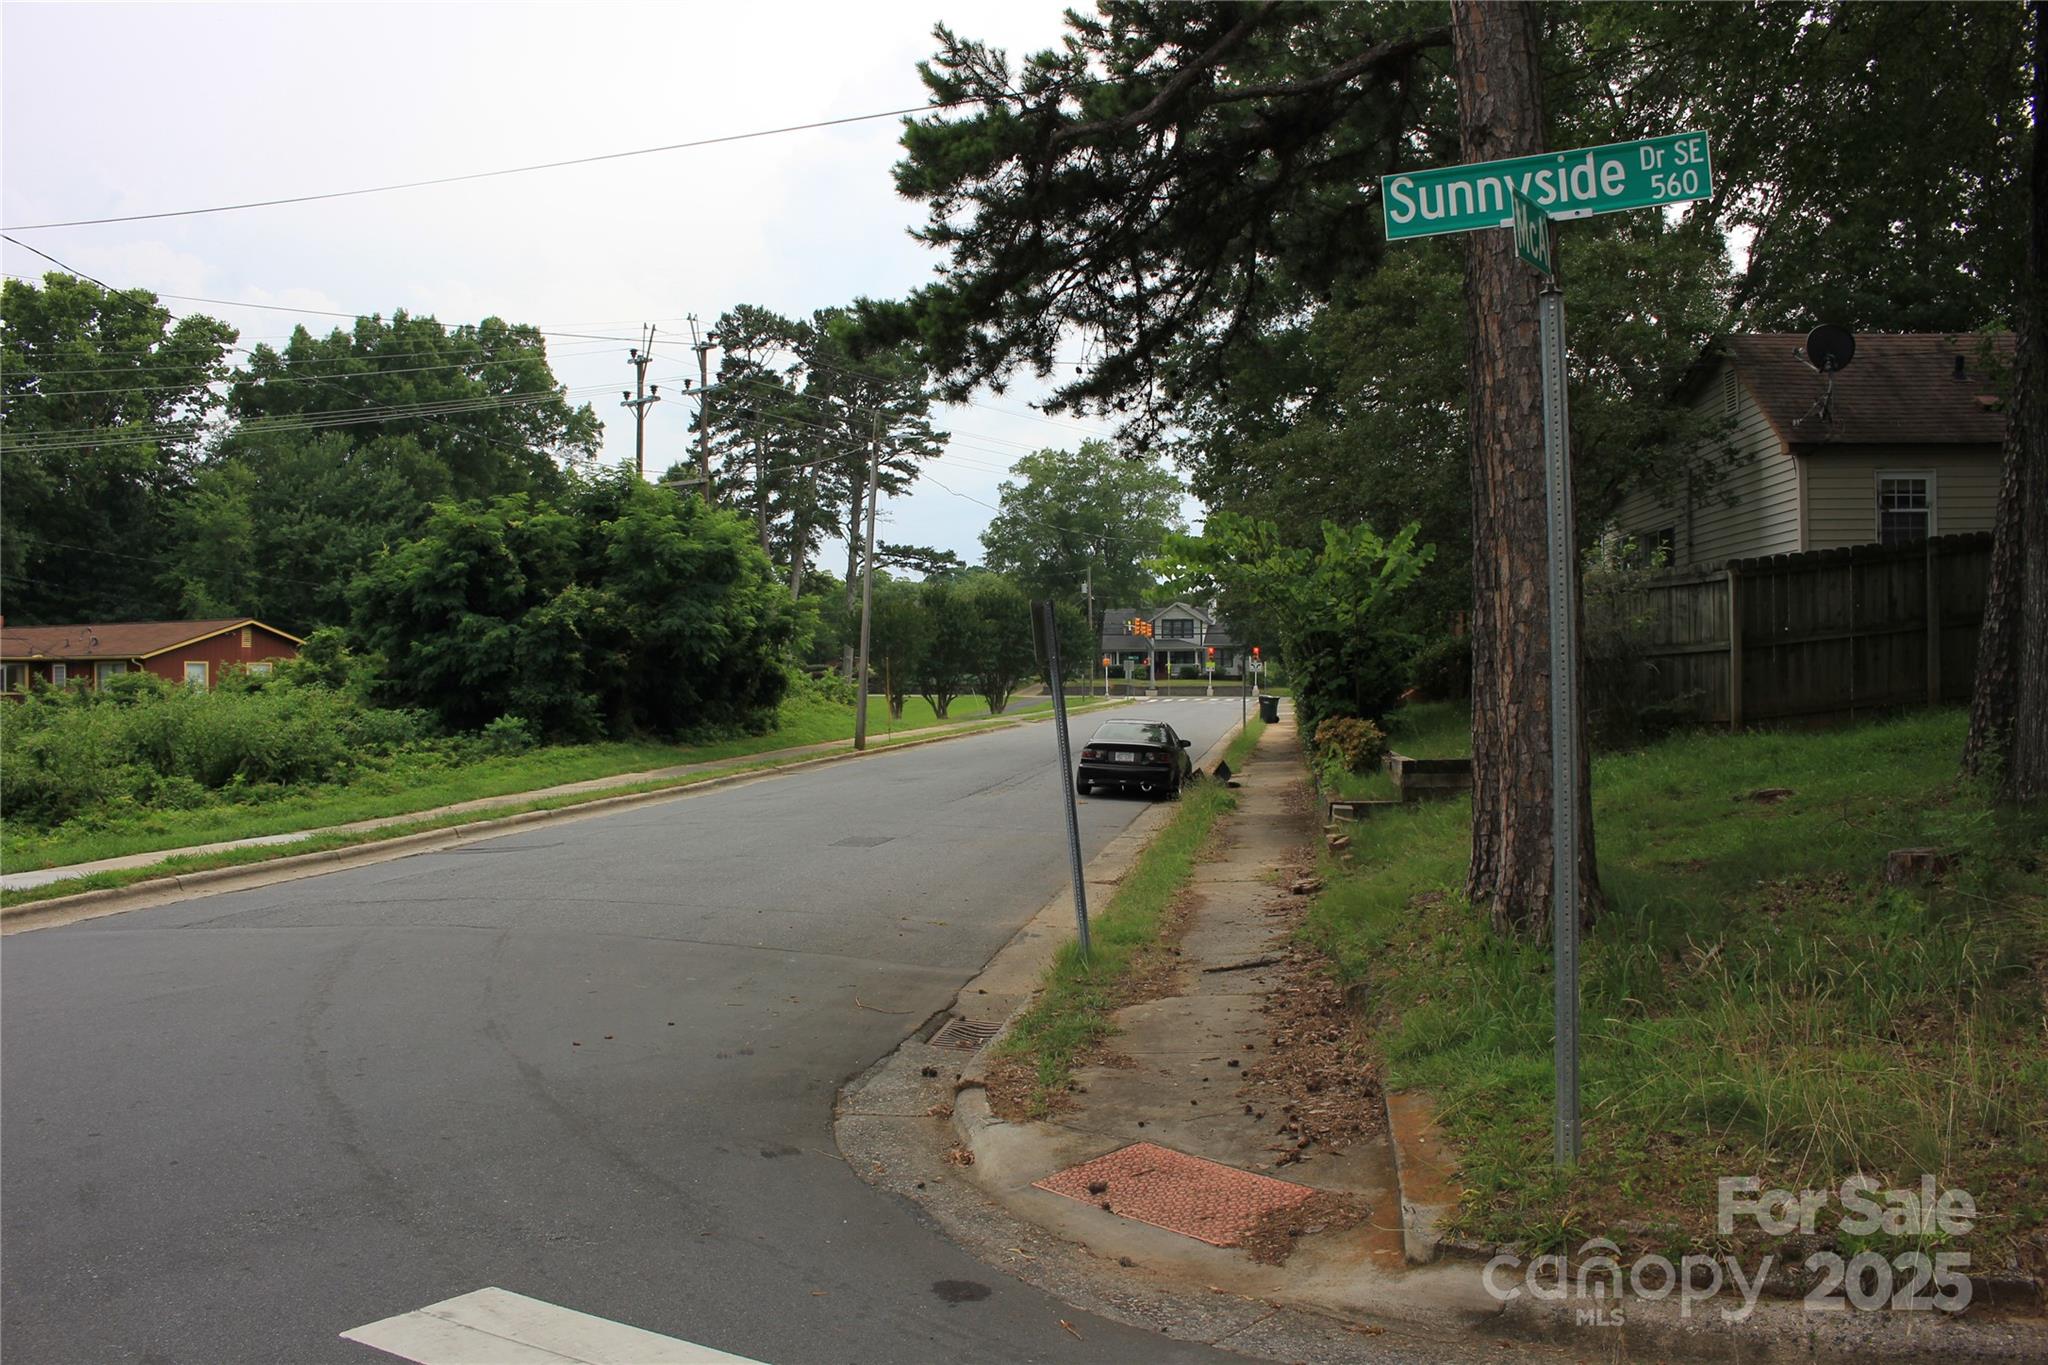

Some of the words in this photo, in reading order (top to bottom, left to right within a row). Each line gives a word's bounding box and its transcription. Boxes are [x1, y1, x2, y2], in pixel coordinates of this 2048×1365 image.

[1640, 145, 1665, 171] Dr
[1674, 138, 1704, 166] SE
[1651, 169, 1698, 200] 560
